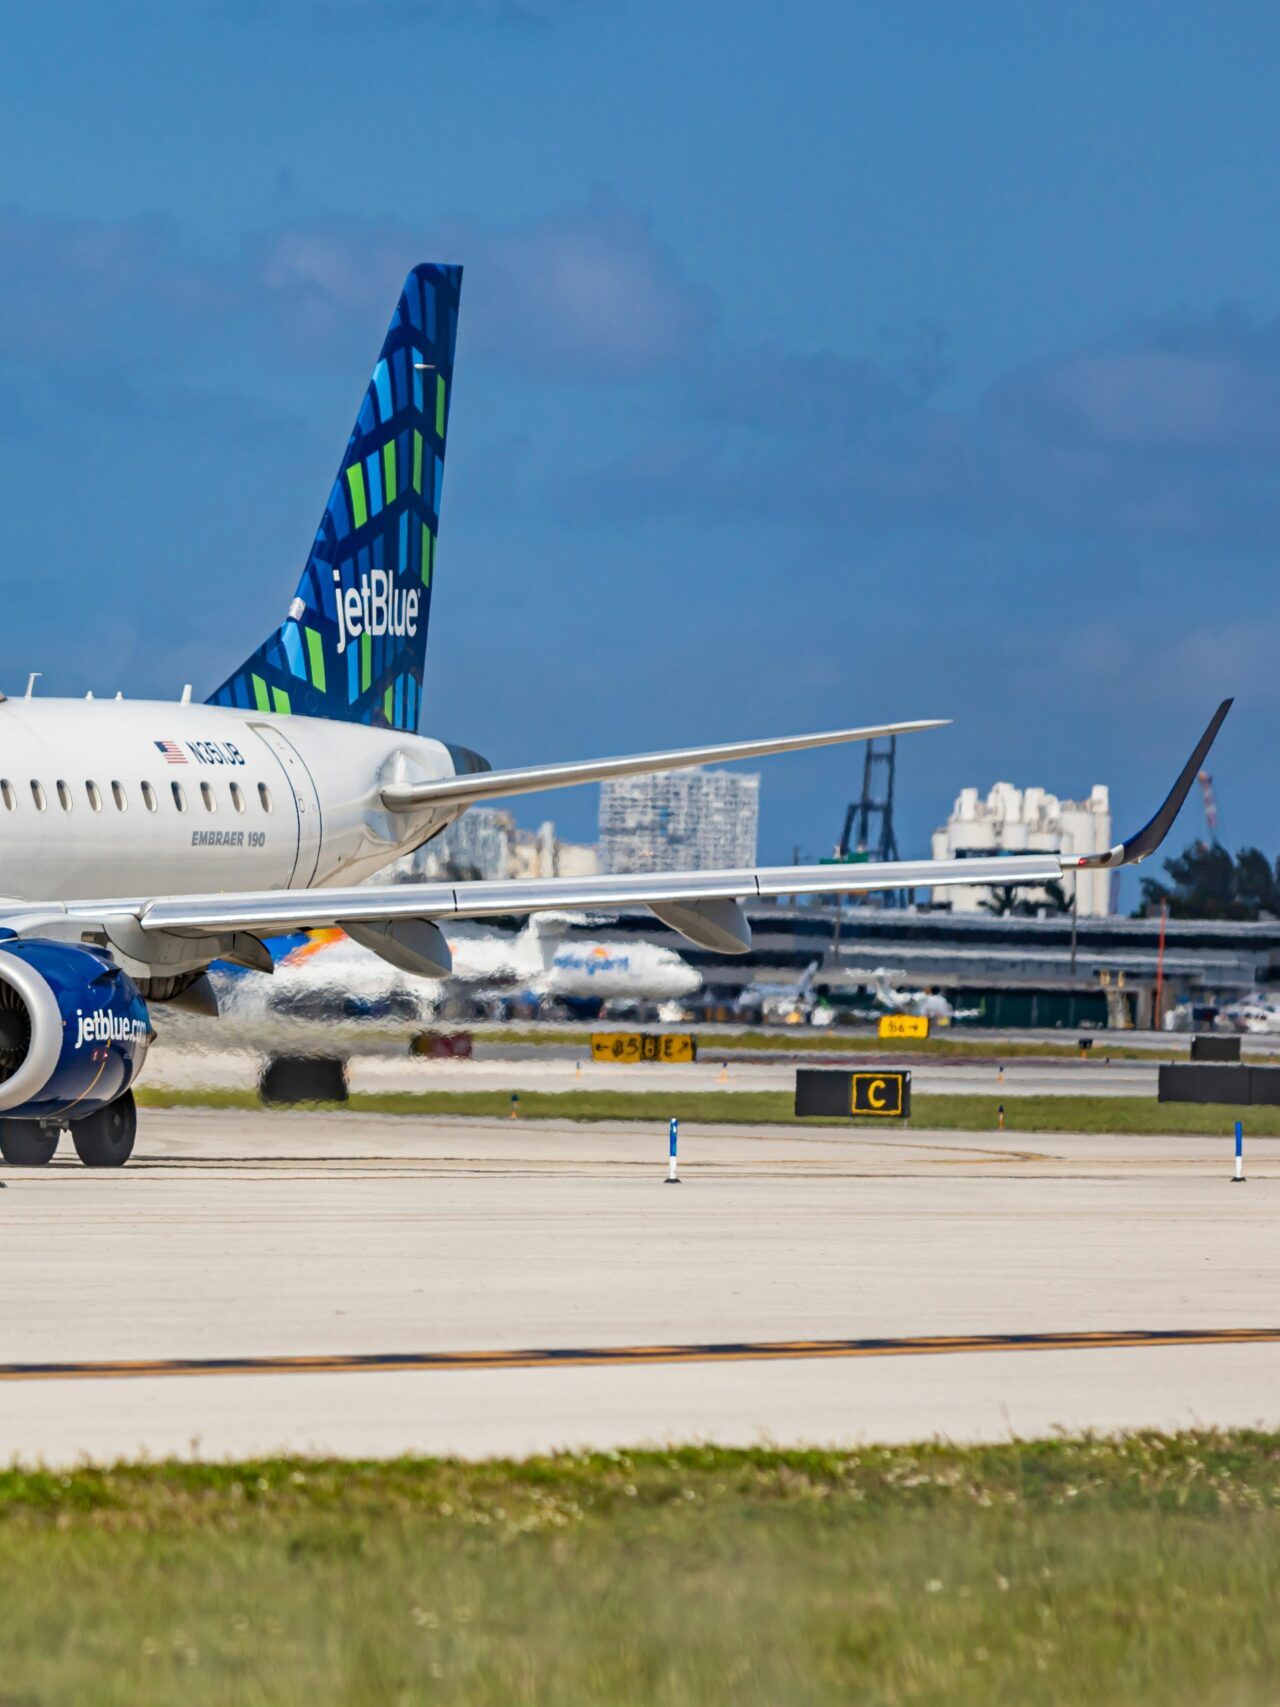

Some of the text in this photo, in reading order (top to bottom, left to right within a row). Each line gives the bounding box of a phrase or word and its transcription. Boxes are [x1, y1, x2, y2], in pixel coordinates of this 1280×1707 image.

[332, 569, 419, 654] jetBlue
[185, 741, 246, 765] N351JB
[191, 830, 266, 848] EMBRAER 190
[867, 1079, 887, 1109] C
